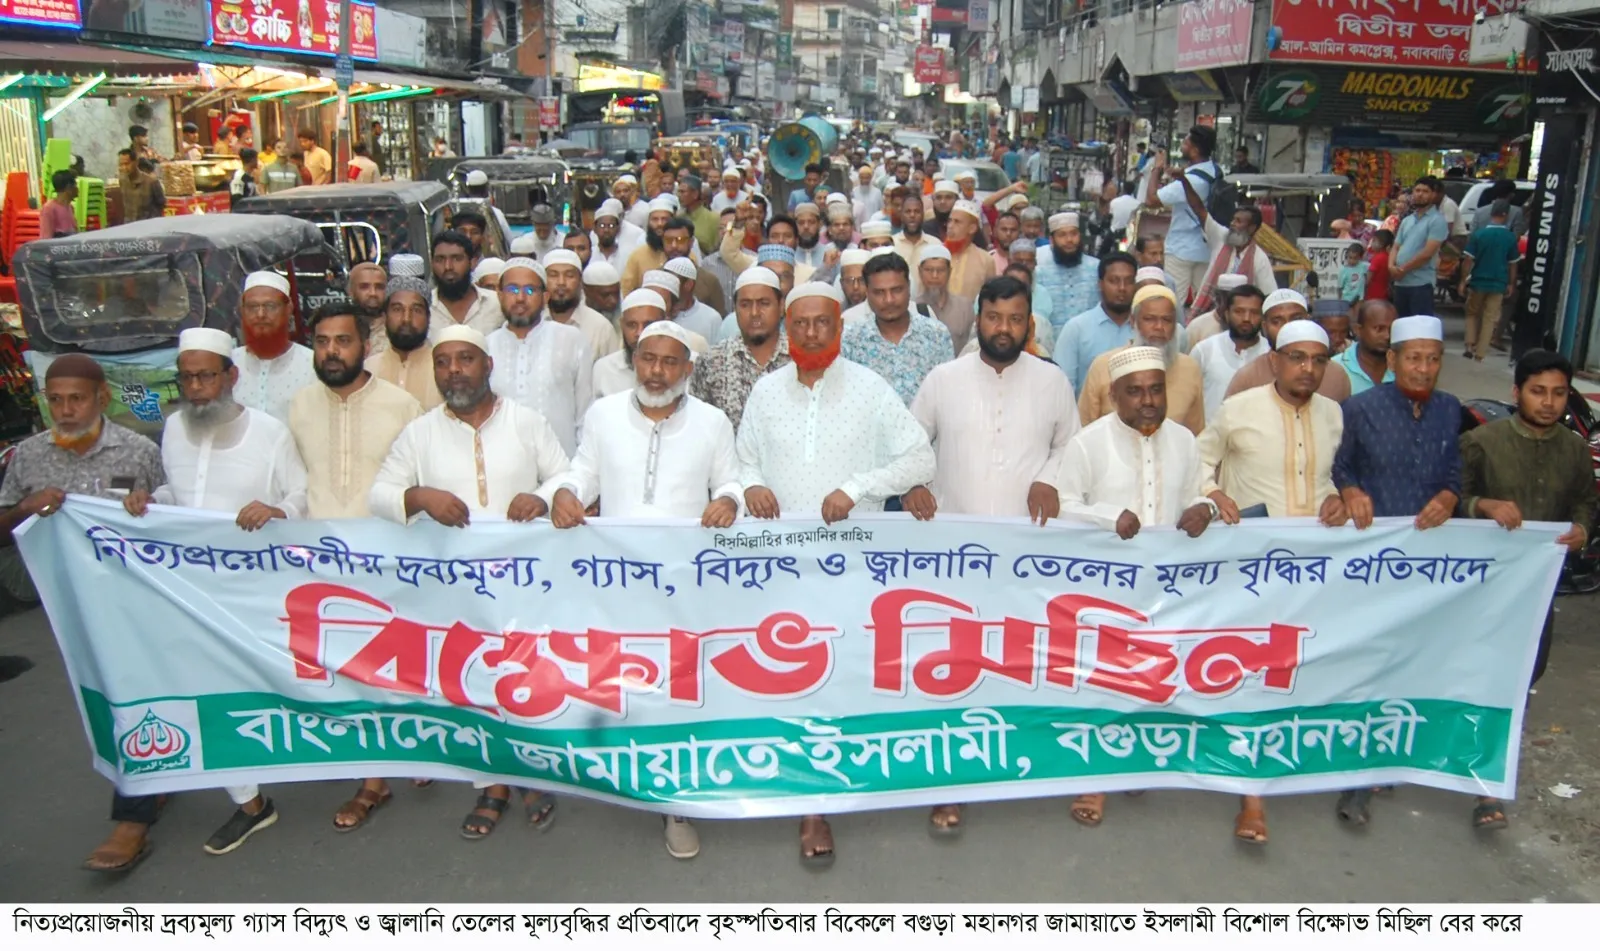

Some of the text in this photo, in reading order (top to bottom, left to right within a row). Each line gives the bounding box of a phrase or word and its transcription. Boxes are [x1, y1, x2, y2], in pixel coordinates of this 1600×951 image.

[1336, 13, 1417, 38] দ্বিতীয়
[1424, 23, 1471, 42] তল
[1280, 38, 1345, 56] আল-আমিন
[1401, 44, 1456, 63] নবাববাড়ি
[1340, 71, 1475, 100] MAGDONALS
[1363, 98, 1431, 113] SNACKS
[1527, 173, 1560, 314] SAMSUNG
[840, 526, 874, 542] রাহিম
[86, 525, 1497, 599] নিত্যপ্রয়োজনীয় দ্রব্যমূল্য, গ্যাস, বিদ্যুৎ ও জ্বালানি তেলের মূল্য বৃদ্ধির প্রতিবাদে
[277, 582, 1314, 721] বিক্ষোভ মিছিল
[228, 700, 1427, 792] বাংলাদেশ জামায়াতে ইসলামী, বগুড়া মহানগরী
